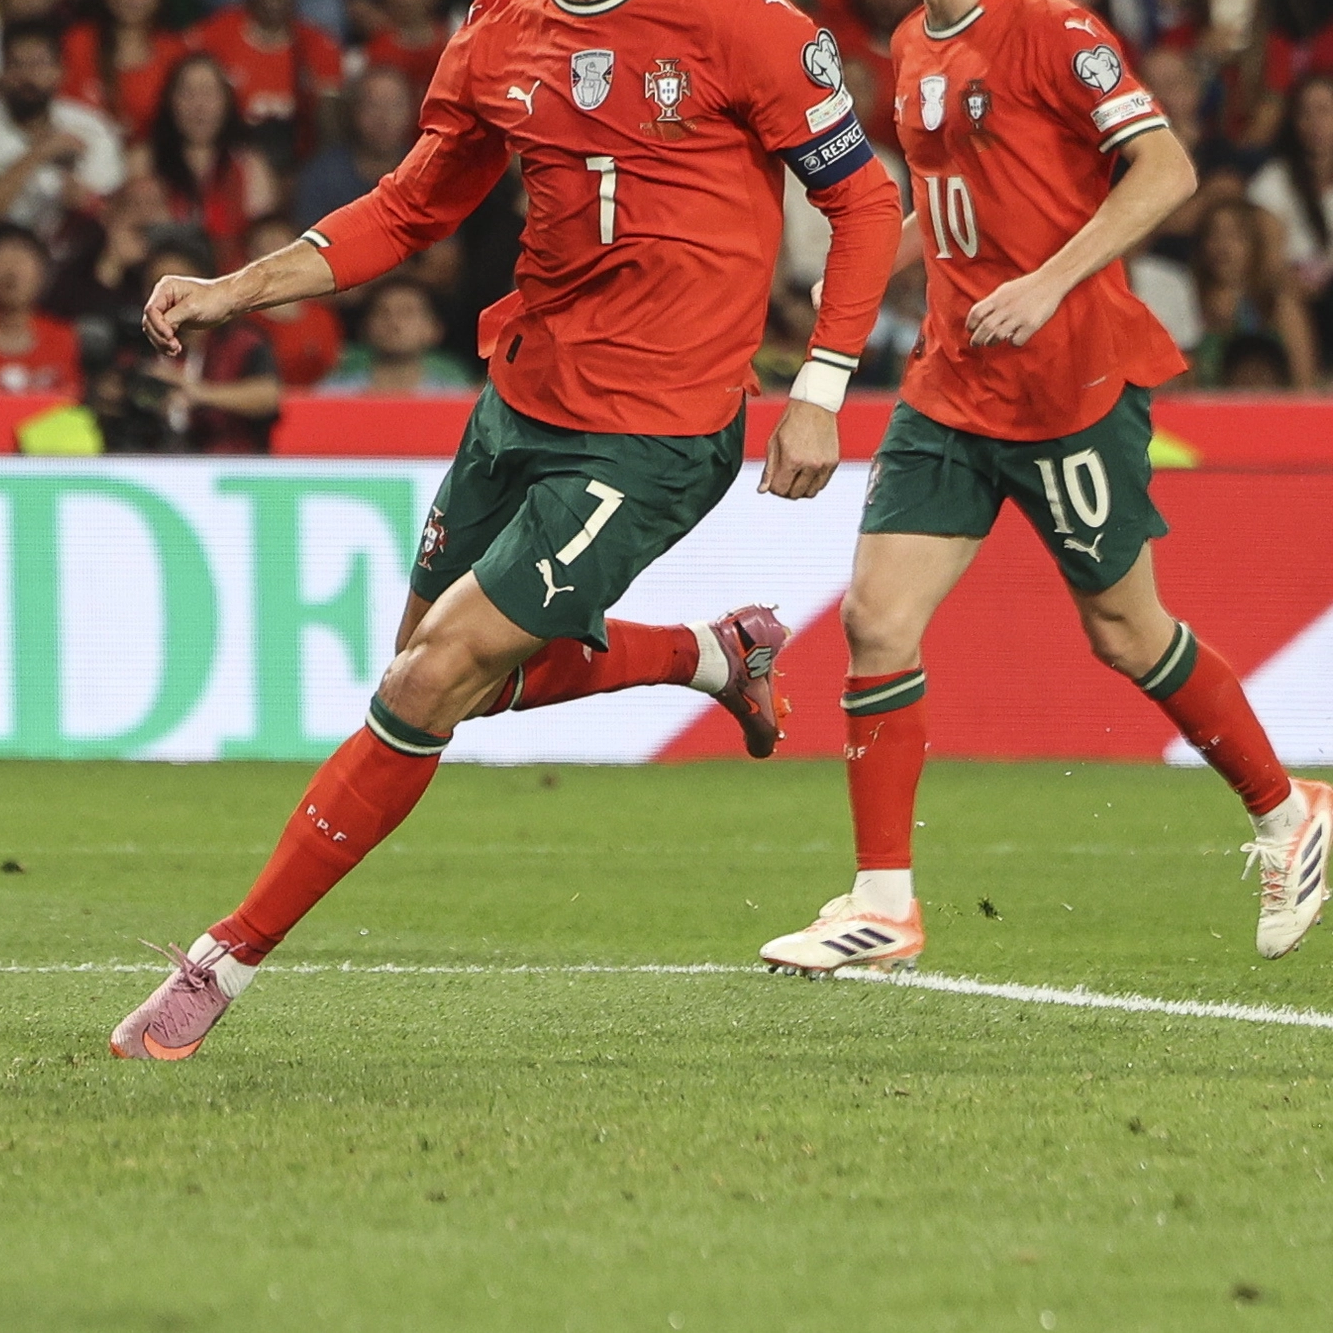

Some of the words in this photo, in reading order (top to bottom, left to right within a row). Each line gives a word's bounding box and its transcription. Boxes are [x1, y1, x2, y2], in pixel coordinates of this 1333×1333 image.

[924, 176, 979, 259] 10
[555, 479, 626, 566] 7
[1033, 446, 1111, 534] 10
